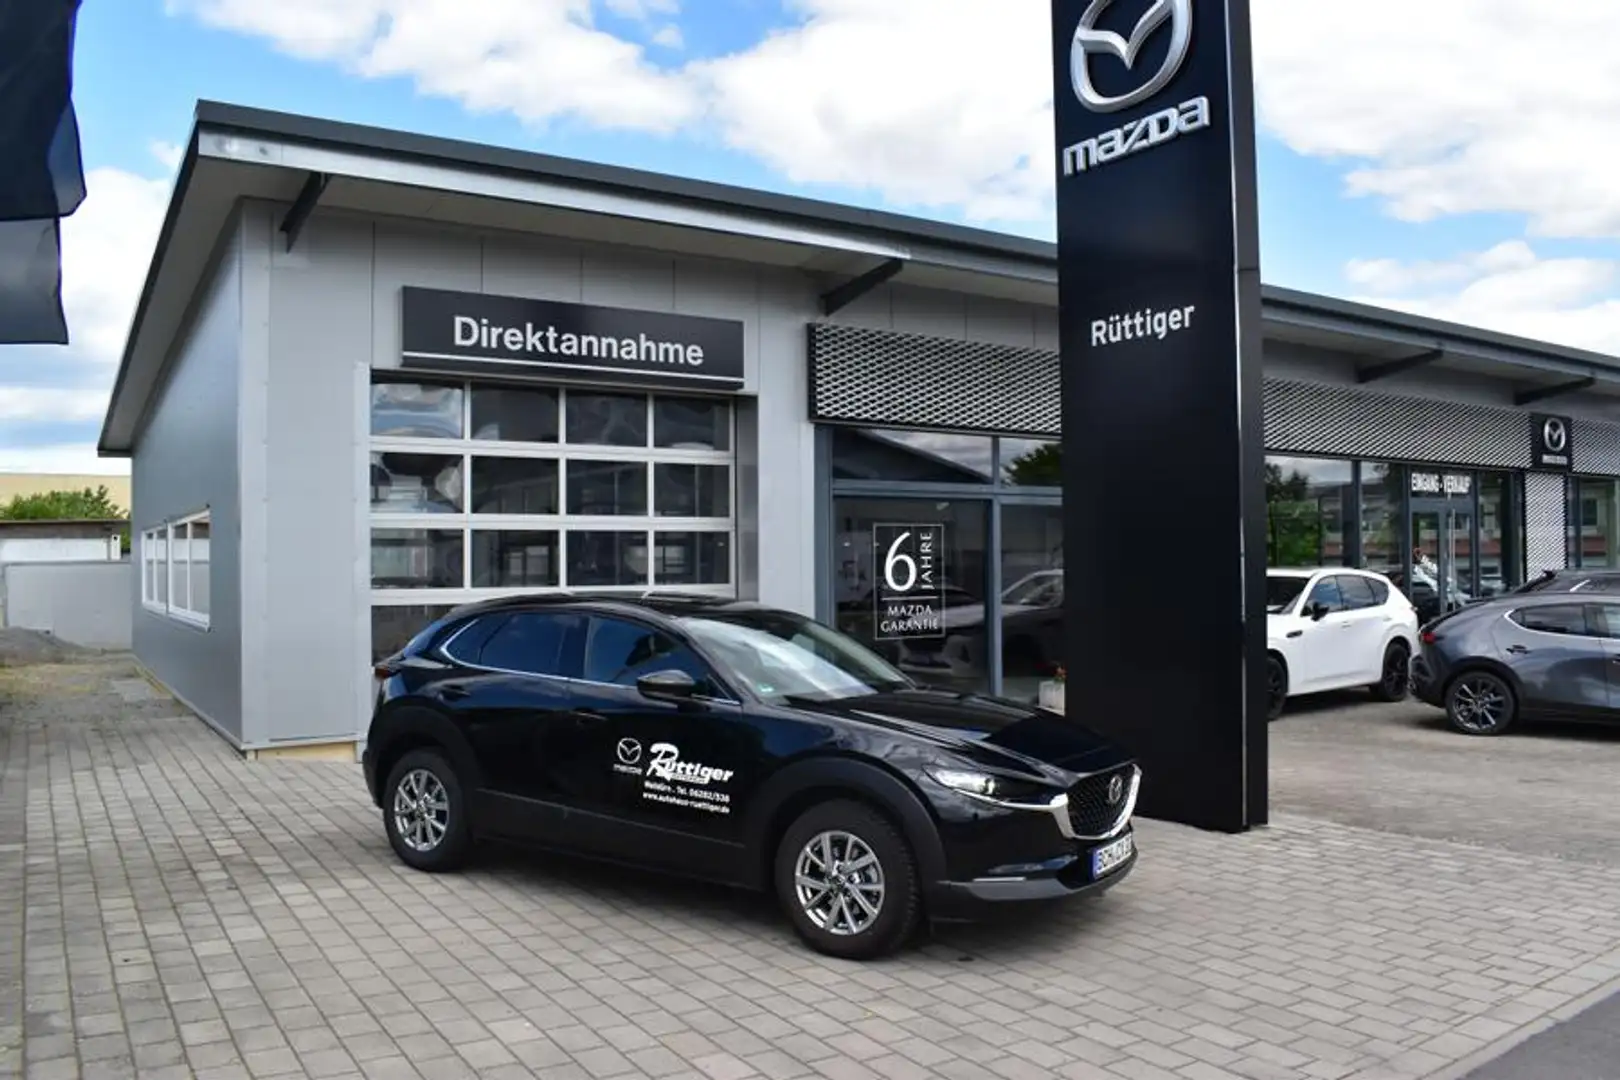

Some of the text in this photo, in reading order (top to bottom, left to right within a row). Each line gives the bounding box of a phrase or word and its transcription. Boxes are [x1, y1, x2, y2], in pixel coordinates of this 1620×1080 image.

[453, 315, 705, 367] Direktannahme
[1091, 305, 1196, 348] Rüttiger
[884, 531, 917, 592] 6
[920, 532, 935, 590] JAHRE
[880, 618, 939, 632] GARANTIE
[887, 604, 933, 617] MAZDA
